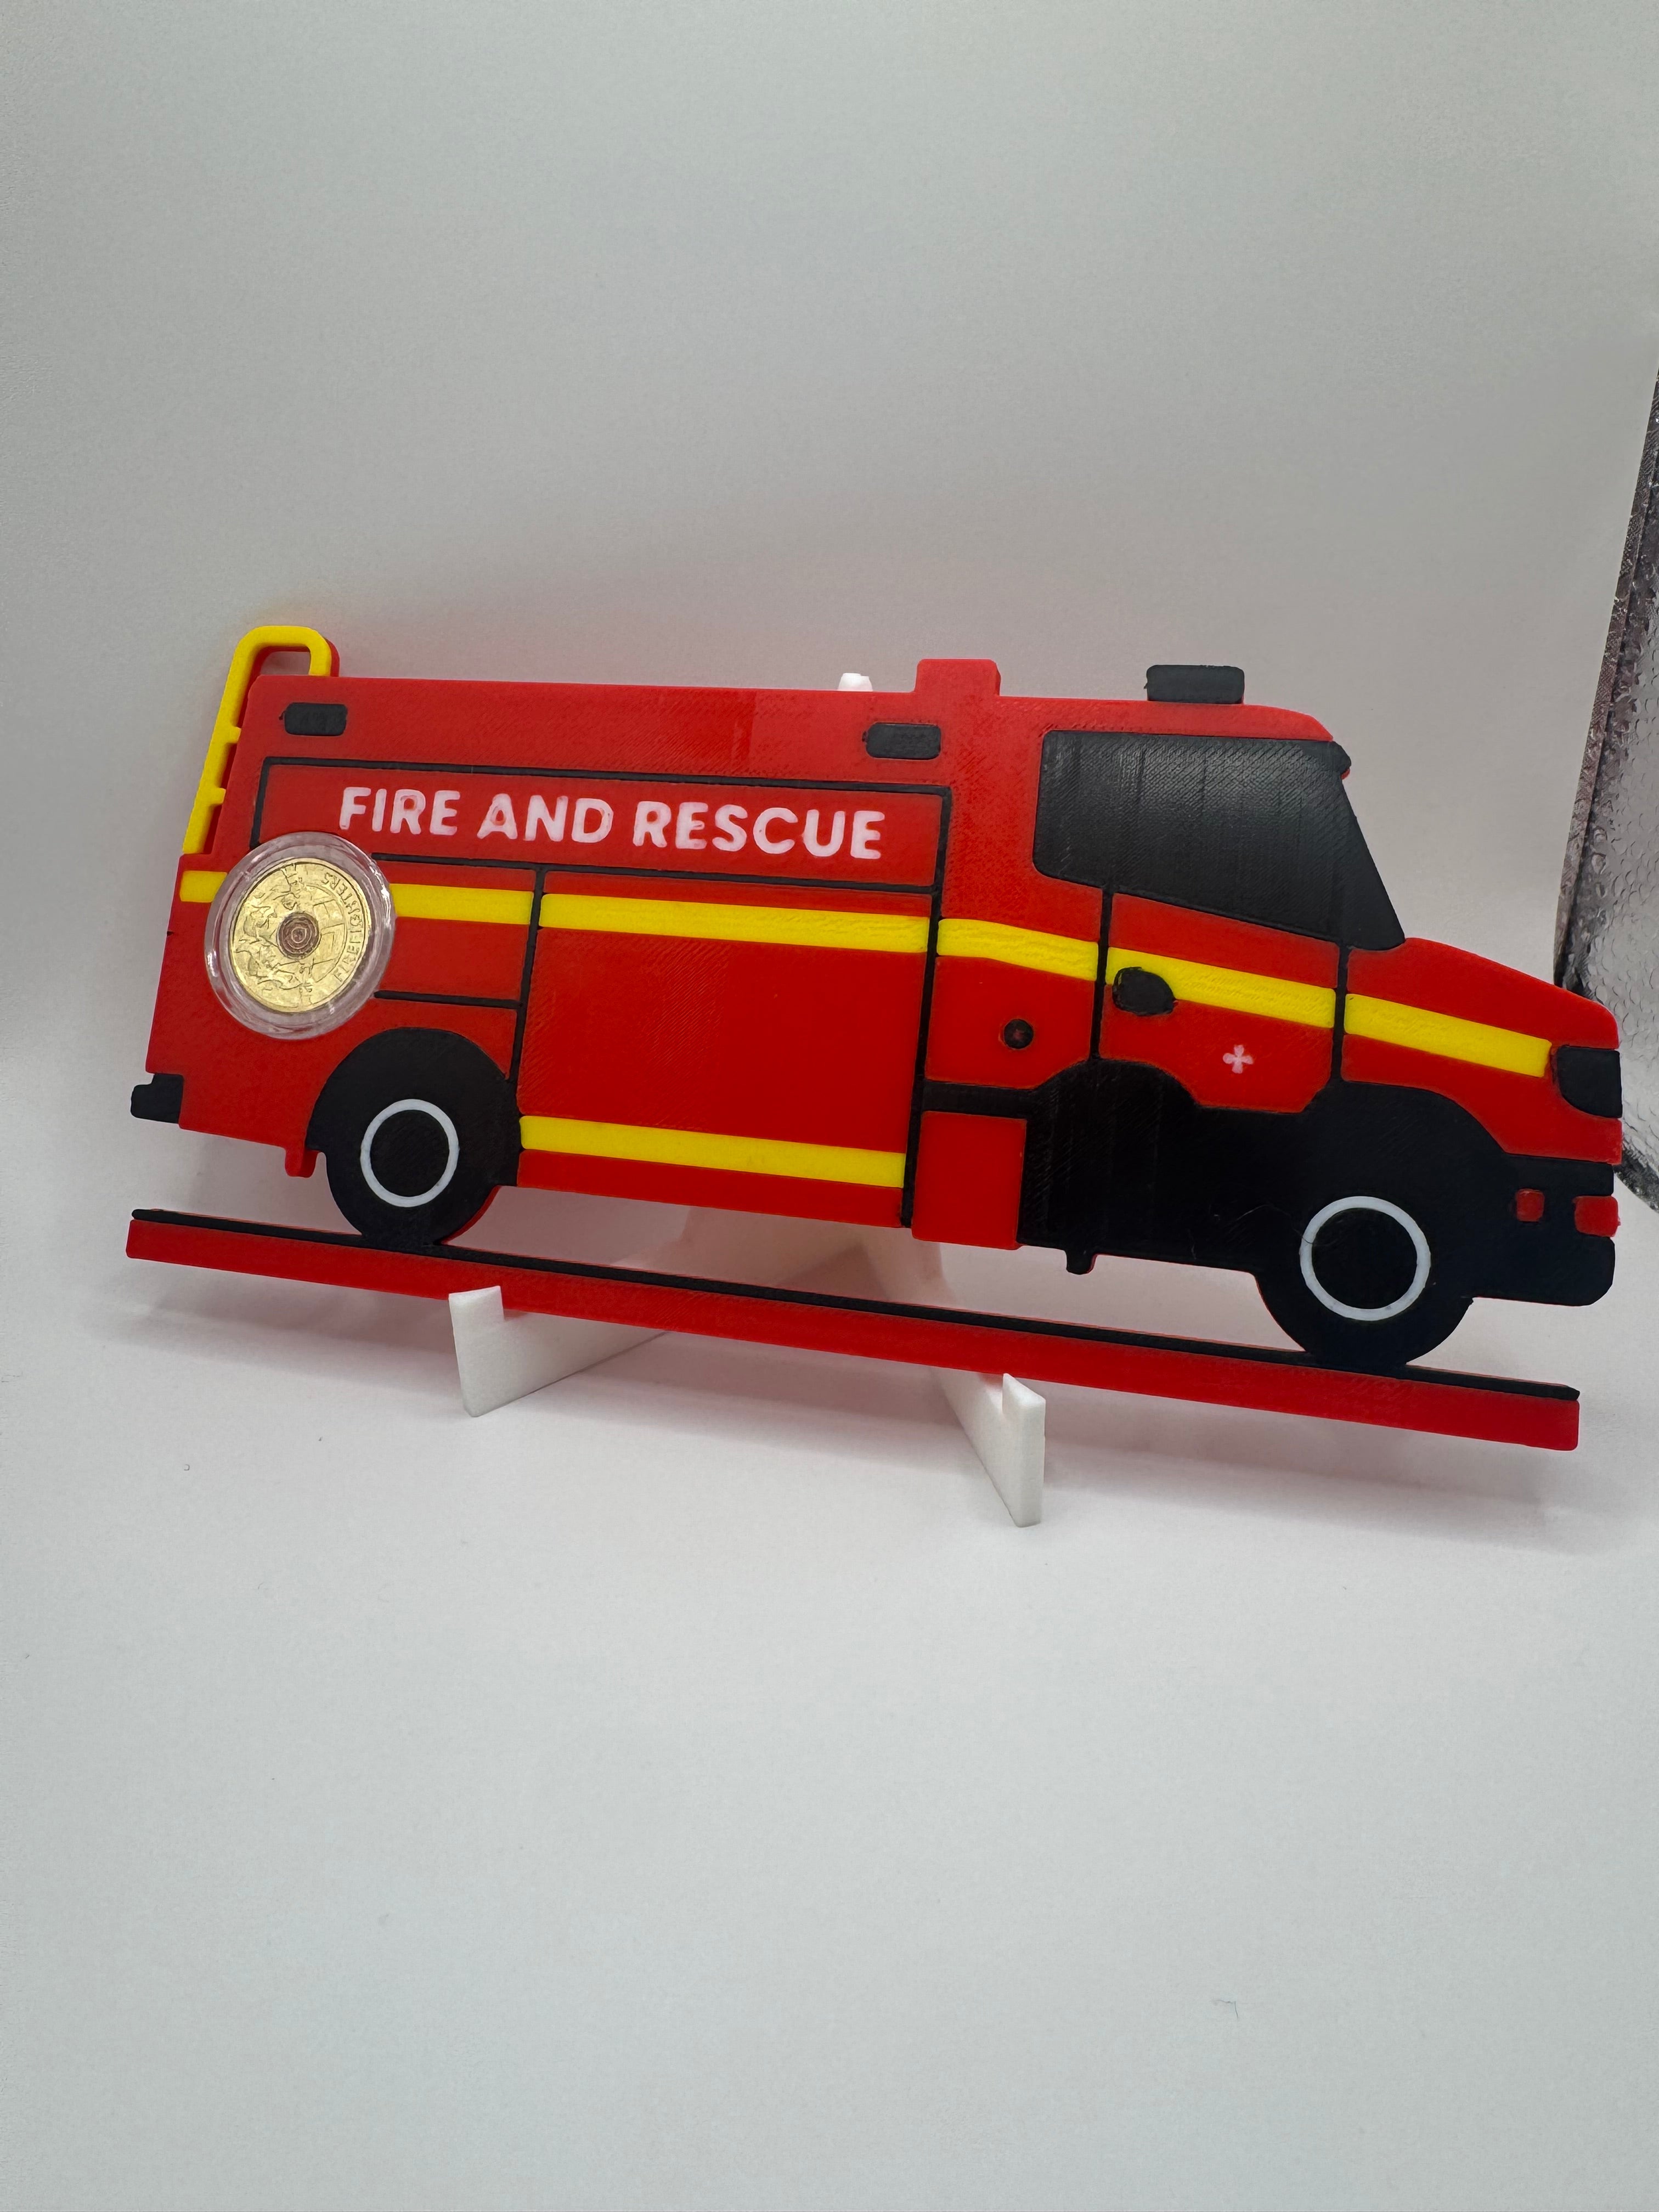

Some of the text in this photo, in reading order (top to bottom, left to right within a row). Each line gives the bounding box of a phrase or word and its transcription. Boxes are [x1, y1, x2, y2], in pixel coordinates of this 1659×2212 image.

[340, 787, 885, 859] FIRE AND RESCUE
